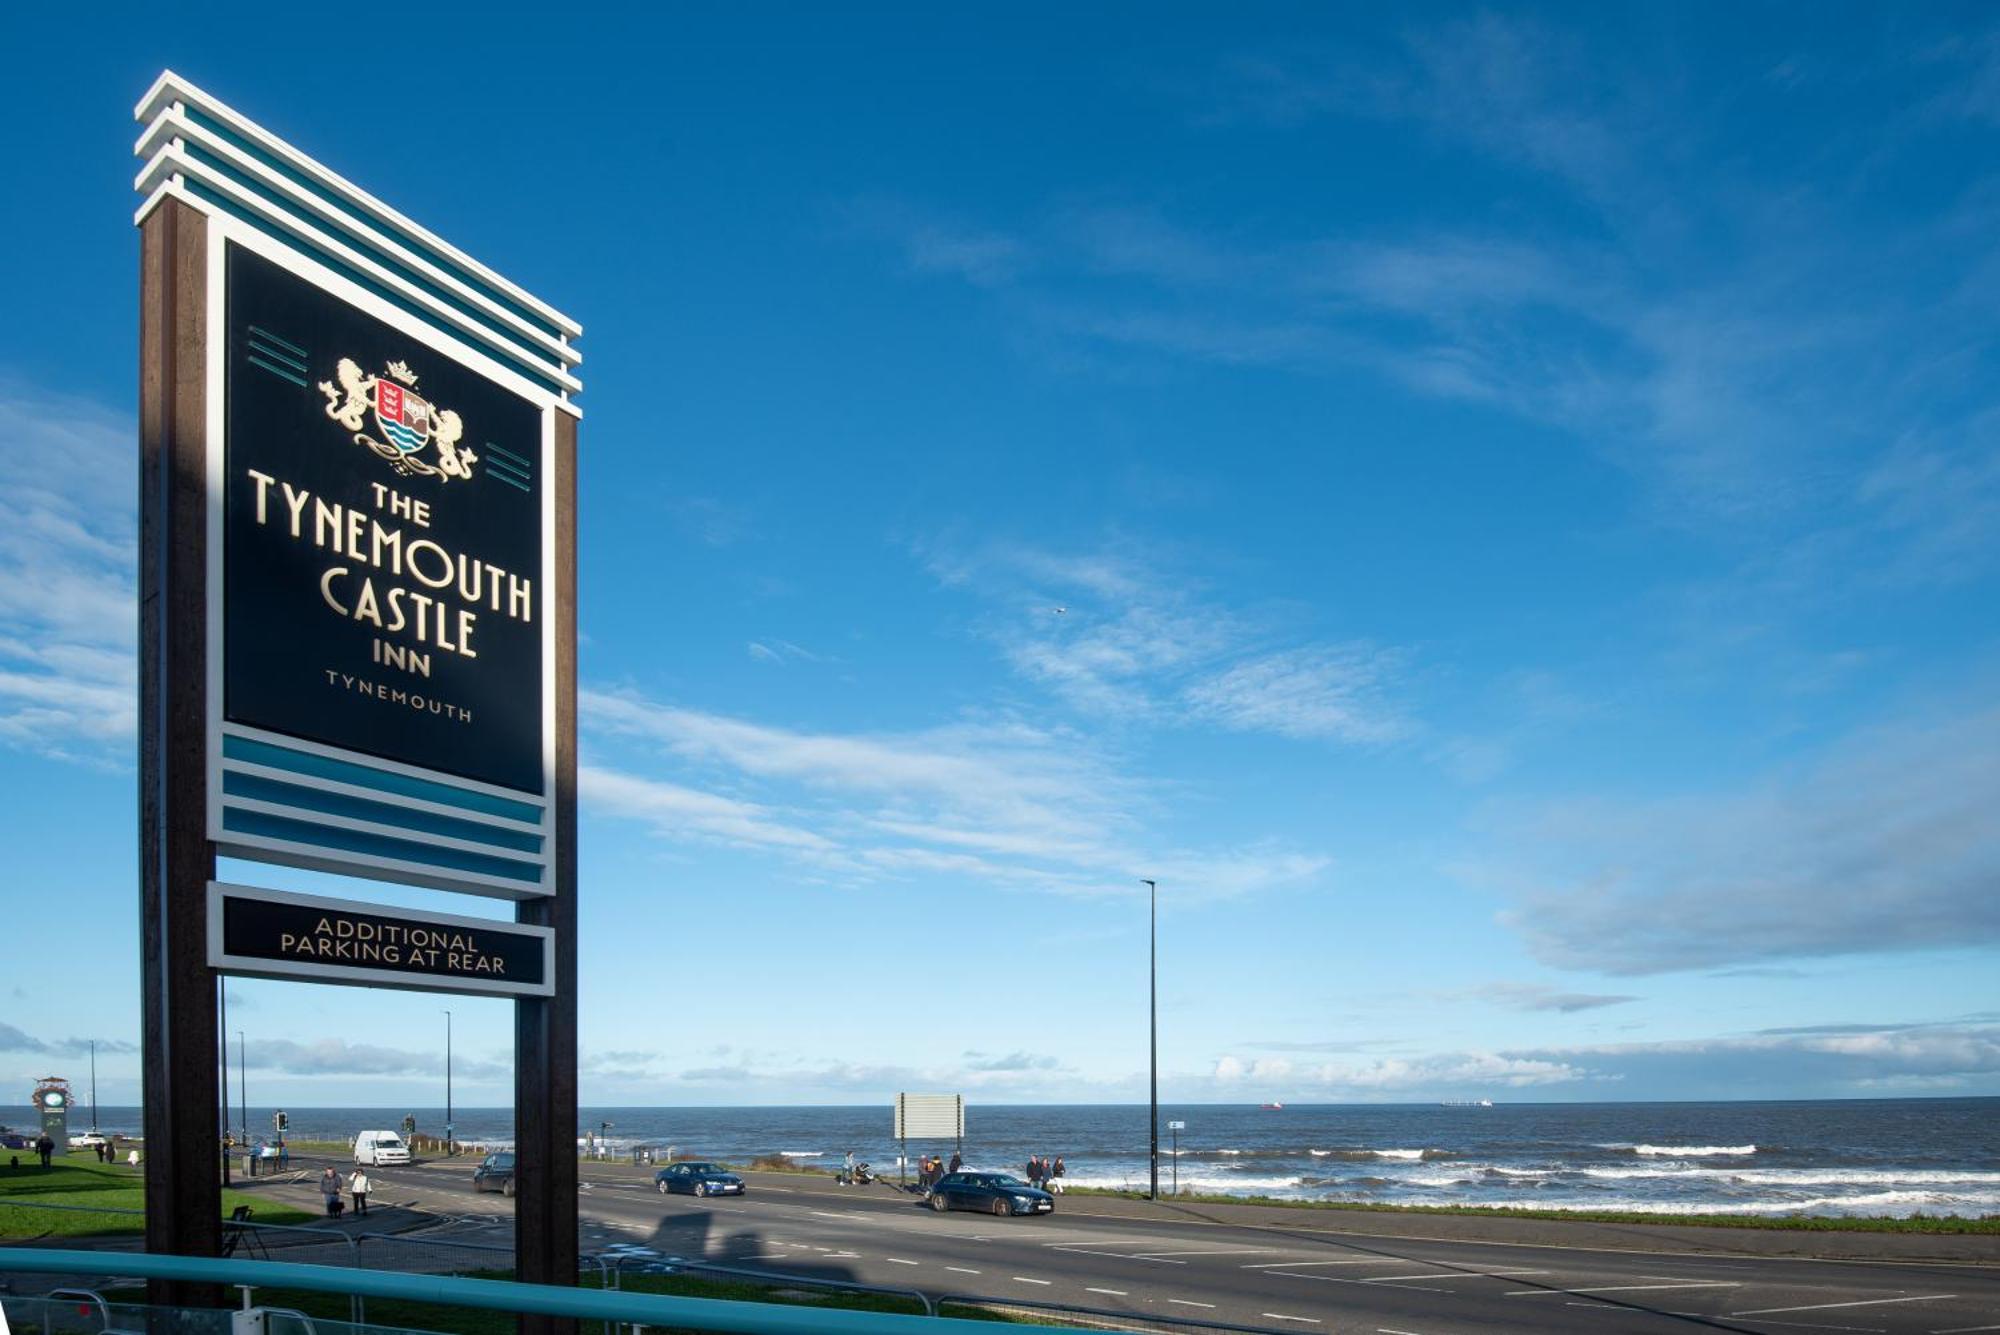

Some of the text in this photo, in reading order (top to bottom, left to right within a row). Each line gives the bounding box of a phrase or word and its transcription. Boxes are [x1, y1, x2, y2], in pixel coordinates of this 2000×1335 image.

[371, 482, 431, 528] THE
[248, 469, 531, 622] TYNEMOUTH
[320, 567, 477, 658] CASTLE
[373, 638, 431, 677] INN
[326, 670, 471, 723] TYNEMOUTH
[281, 934, 505, 974] PARKING AT REAR
[315, 918, 478, 953] ADDITIONAL
